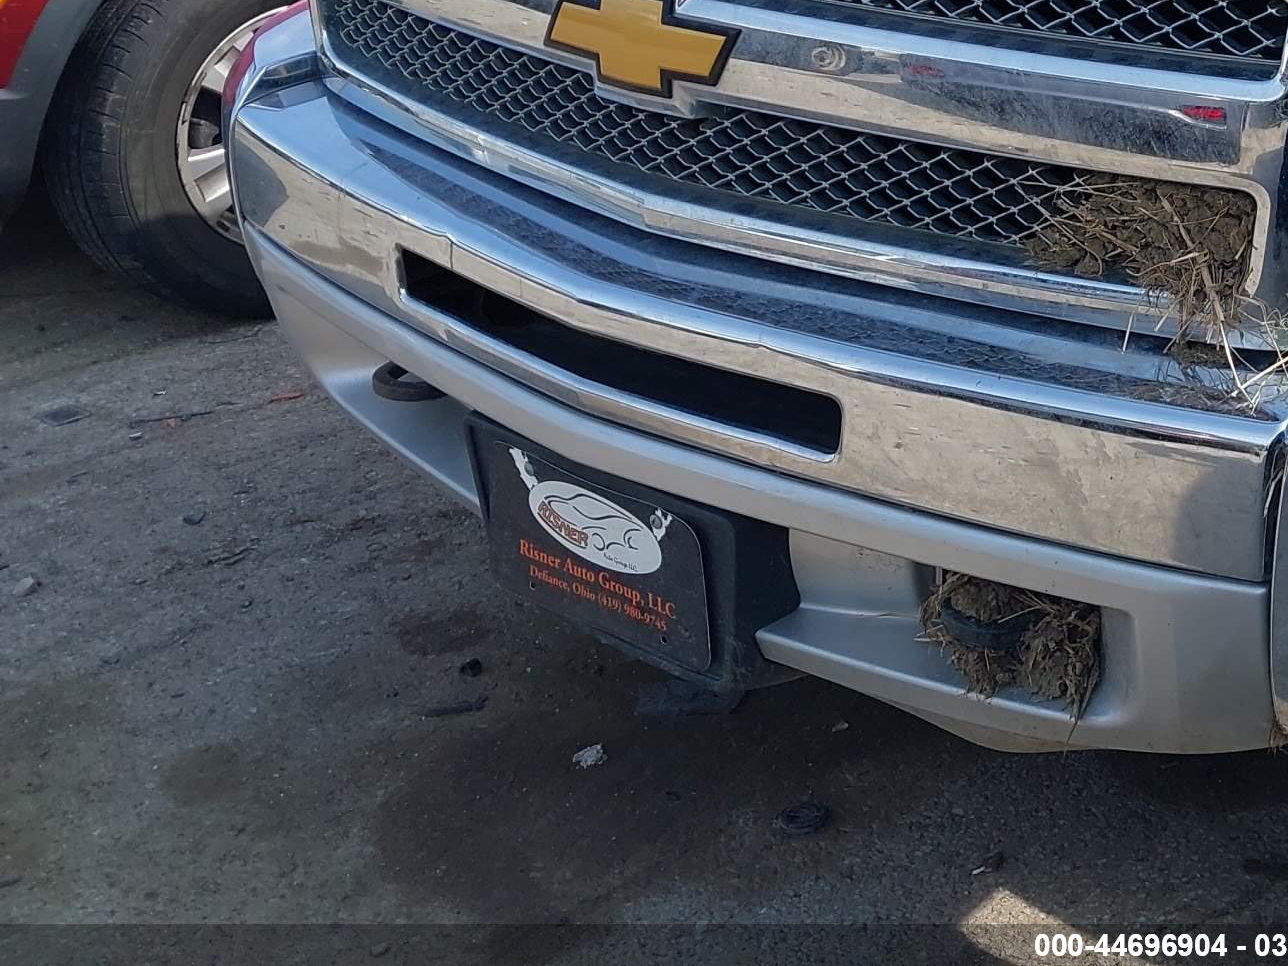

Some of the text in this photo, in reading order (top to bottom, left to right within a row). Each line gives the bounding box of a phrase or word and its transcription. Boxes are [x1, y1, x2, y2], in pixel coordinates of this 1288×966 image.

[537, 500, 589, 547] RISNER
[519, 538, 677, 620] Risner Auto Group, LLC
[529, 566, 667, 632] Defiance, Ohio (419) 980-9745
